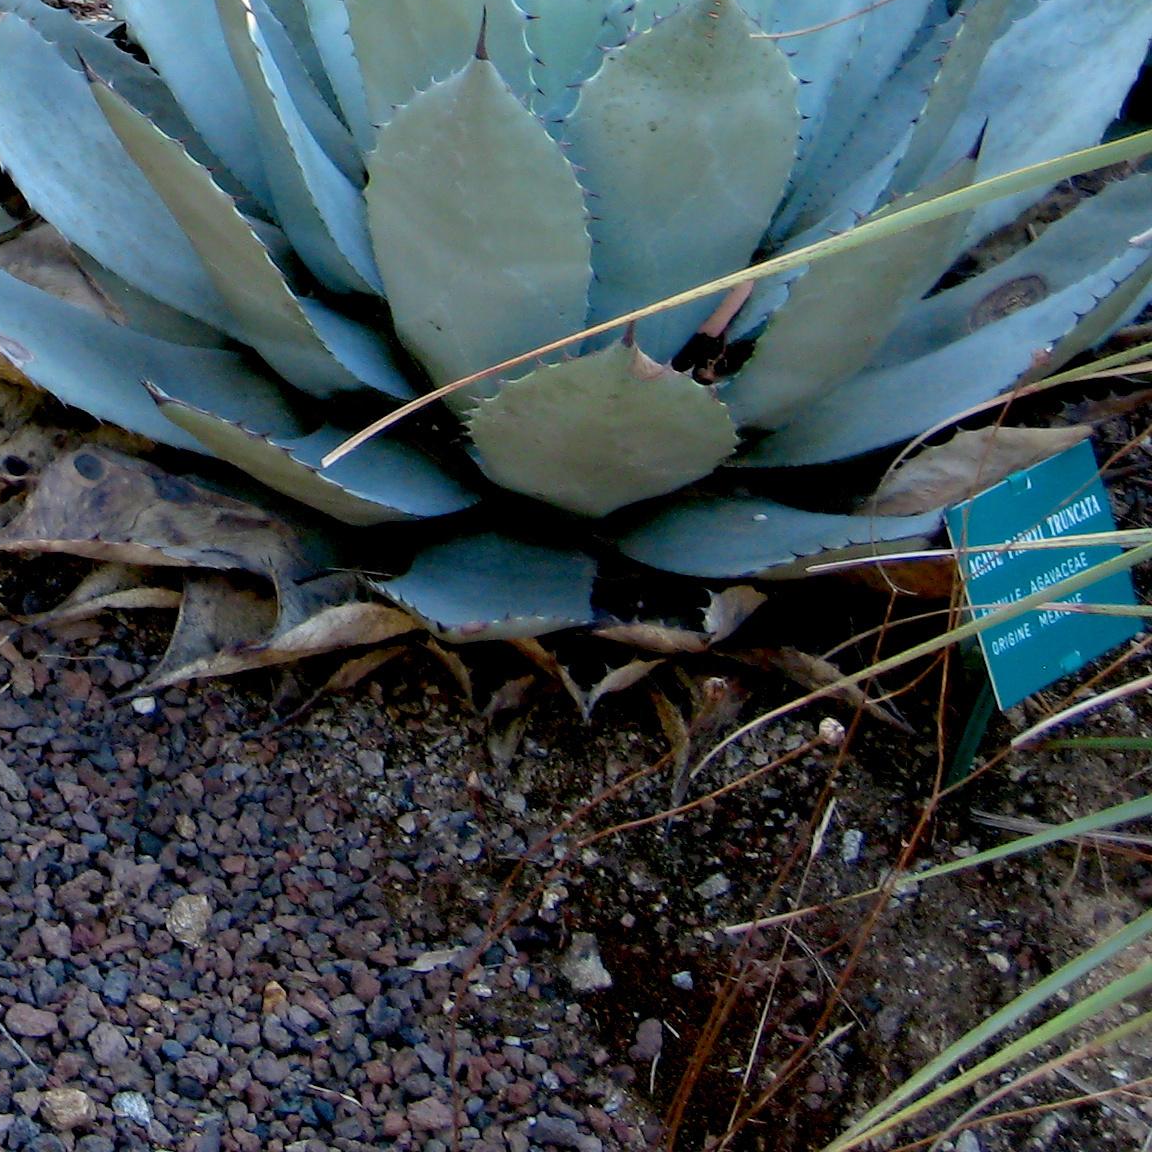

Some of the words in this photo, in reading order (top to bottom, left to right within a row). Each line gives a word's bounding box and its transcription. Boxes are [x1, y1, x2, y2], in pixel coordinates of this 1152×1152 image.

[969, 548, 1004, 580] AGAVE
[1046, 495, 1102, 536] TRUNCATA
[1030, 552, 1089, 594] AGAVACEAE
[991, 622, 1033, 656] ORIGINE
